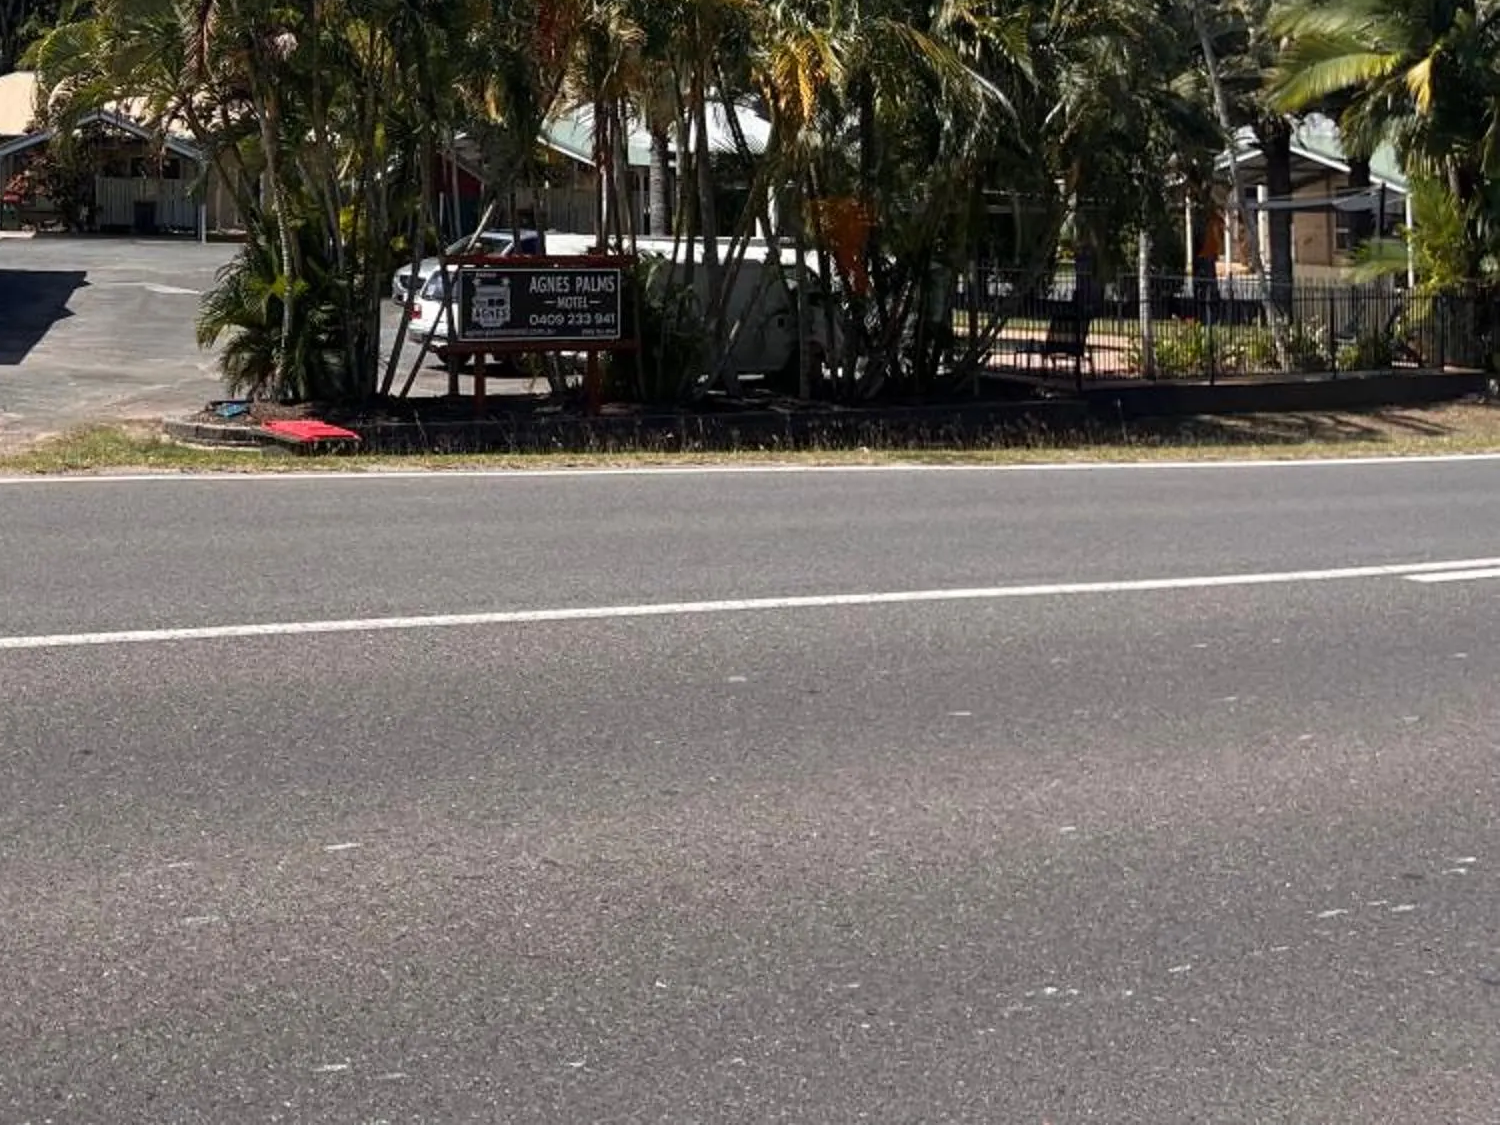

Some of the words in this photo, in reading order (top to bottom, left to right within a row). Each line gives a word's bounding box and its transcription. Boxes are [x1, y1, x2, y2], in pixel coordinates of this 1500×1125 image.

[529, 276, 570, 294] AGNES
[575, 275, 615, 293] PALMS
[556, 296, 588, 308] MOTEL
[529, 313, 565, 325] 0409
[567, 312, 592, 325] 233
[595, 312, 615, 324] 941
